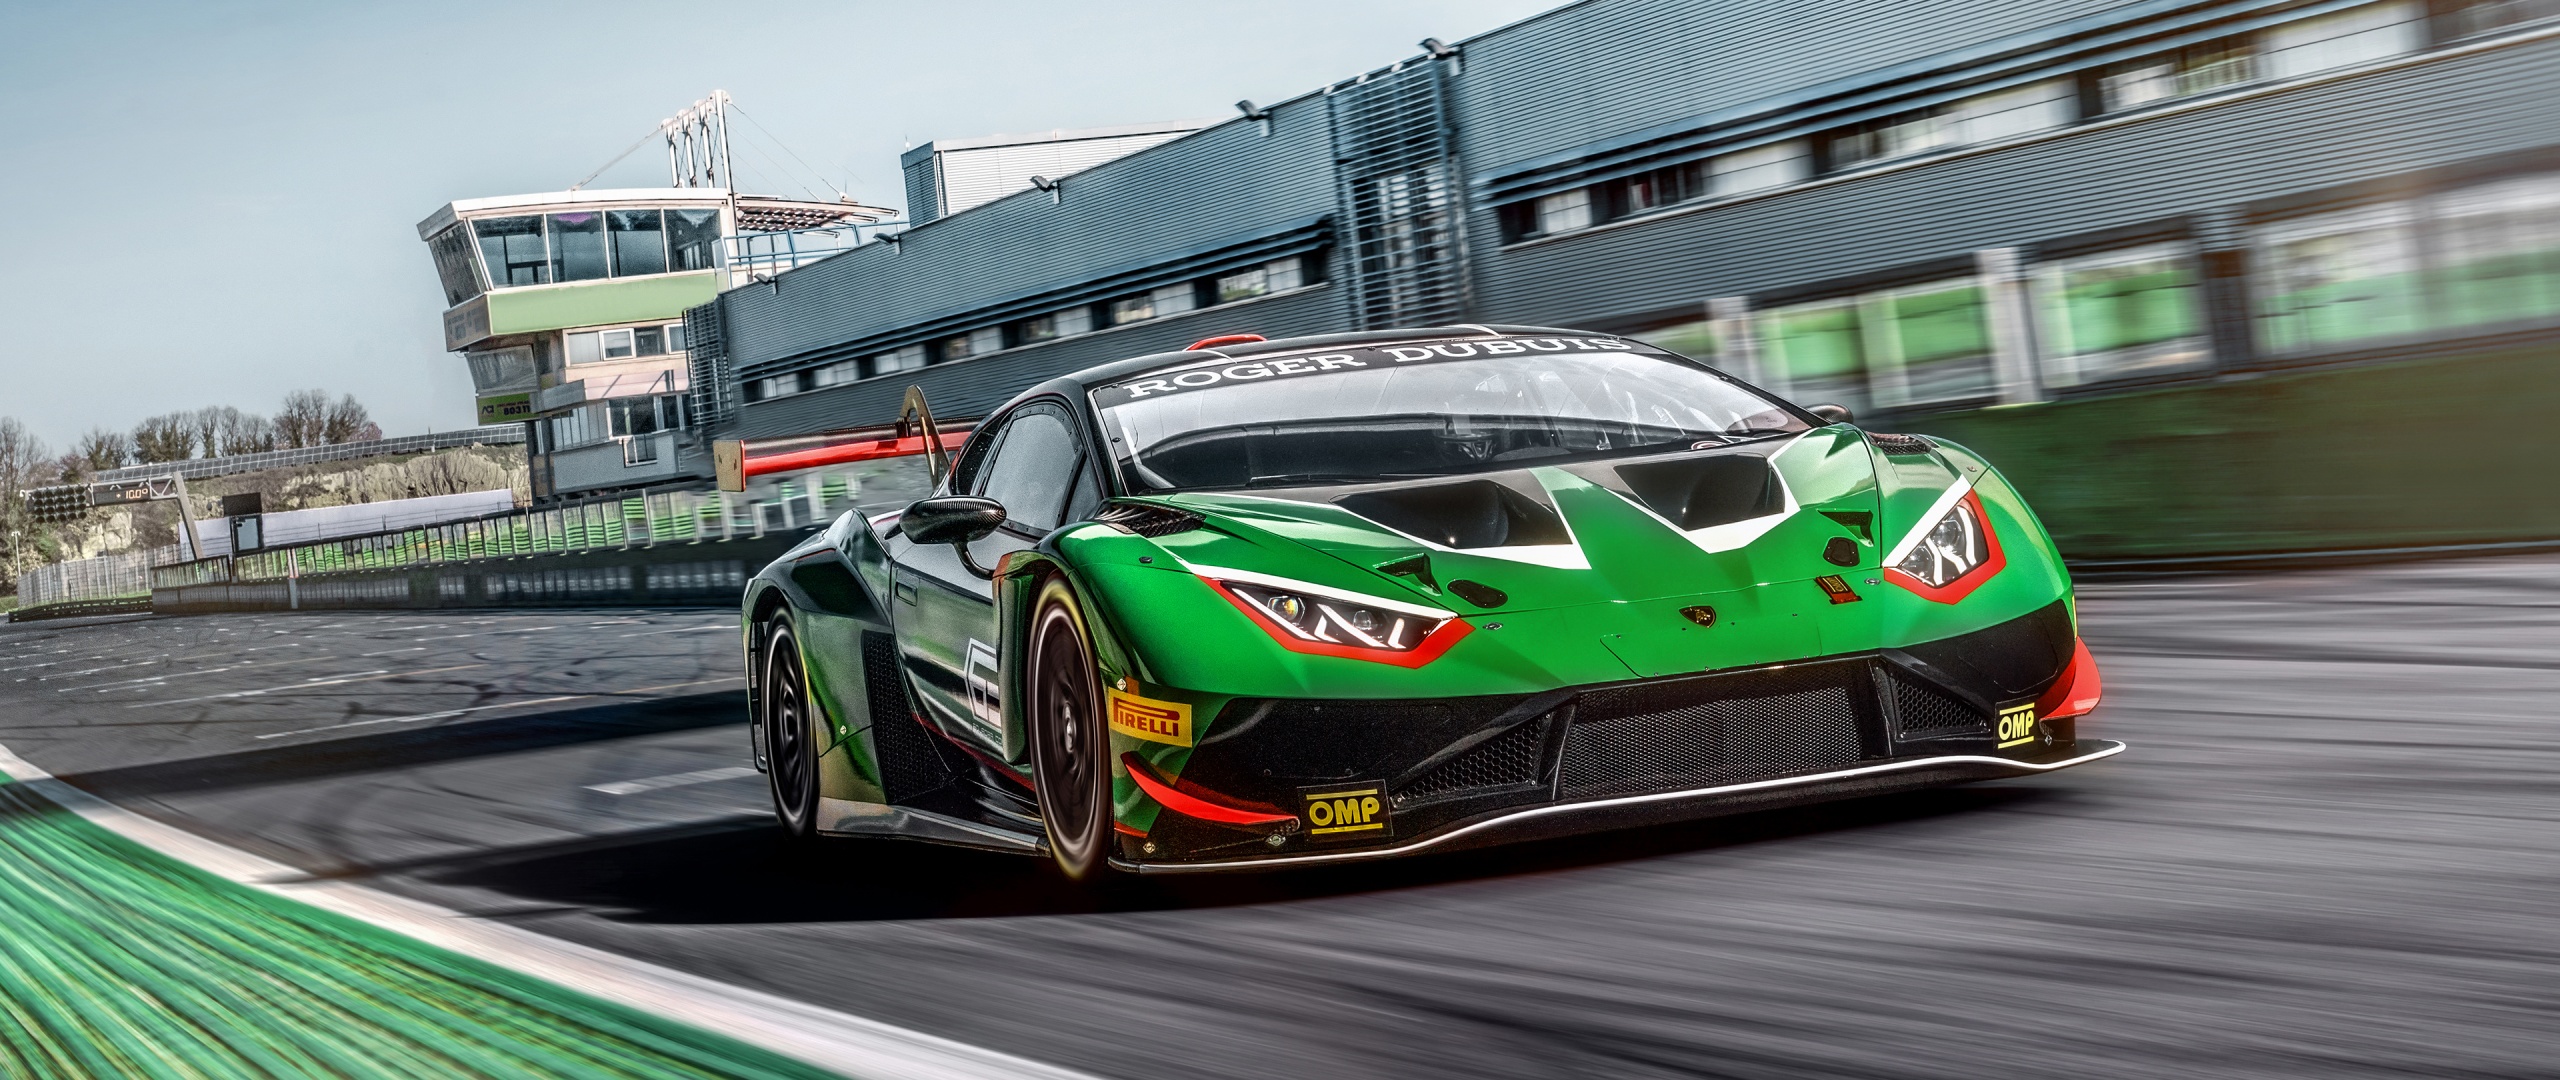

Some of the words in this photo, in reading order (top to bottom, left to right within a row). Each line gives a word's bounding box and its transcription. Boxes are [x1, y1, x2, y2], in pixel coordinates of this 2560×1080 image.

[1122, 353, 1368, 399] ROGER
[1382, 338, 1632, 363] DUBUIS
[1113, 696, 1180, 737] PIRELLI
[1999, 710, 2034, 741] OMP
[1309, 797, 1380, 827] OMP
